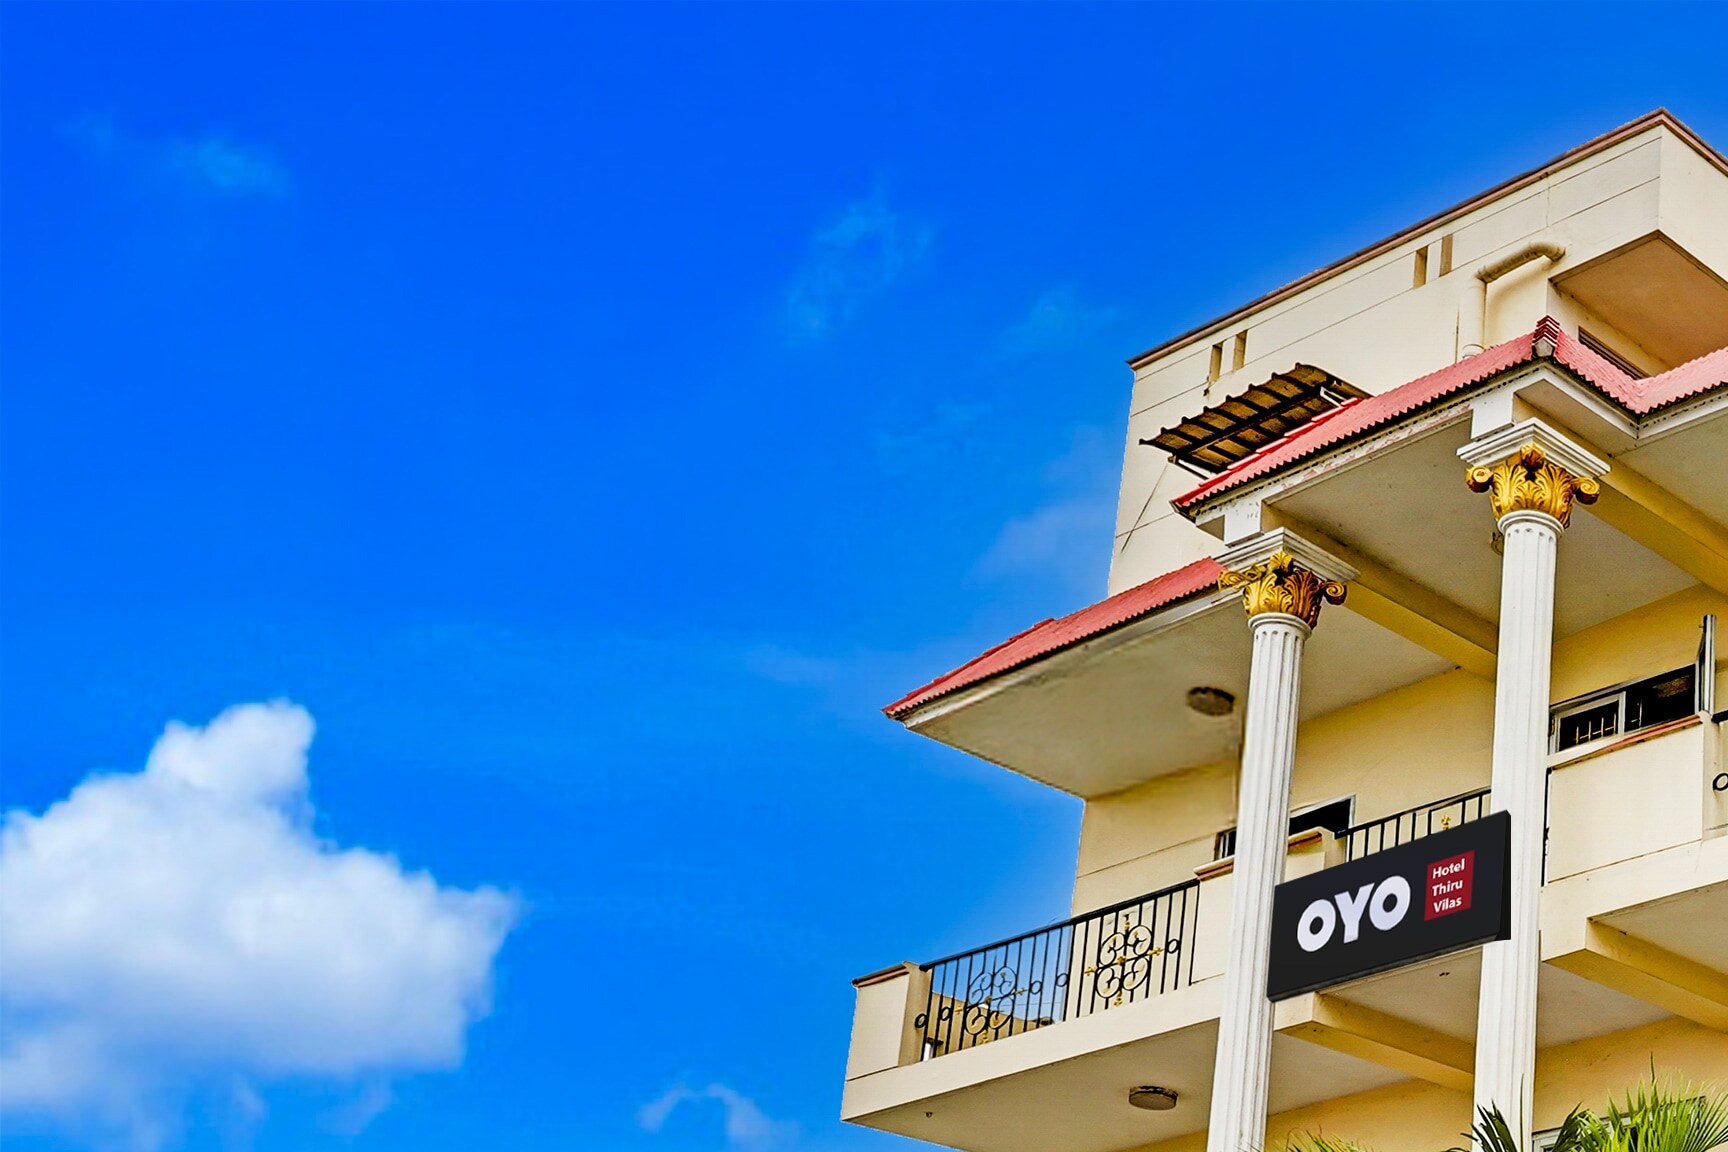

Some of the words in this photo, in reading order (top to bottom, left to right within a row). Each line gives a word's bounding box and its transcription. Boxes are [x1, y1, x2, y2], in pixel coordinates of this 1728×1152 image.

[1432, 858, 1465, 879] Hotel
[1432, 880, 1463, 897] Thiru
[1297, 875, 1411, 952] OYO
[1433, 896, 1462, 913] Vilas
